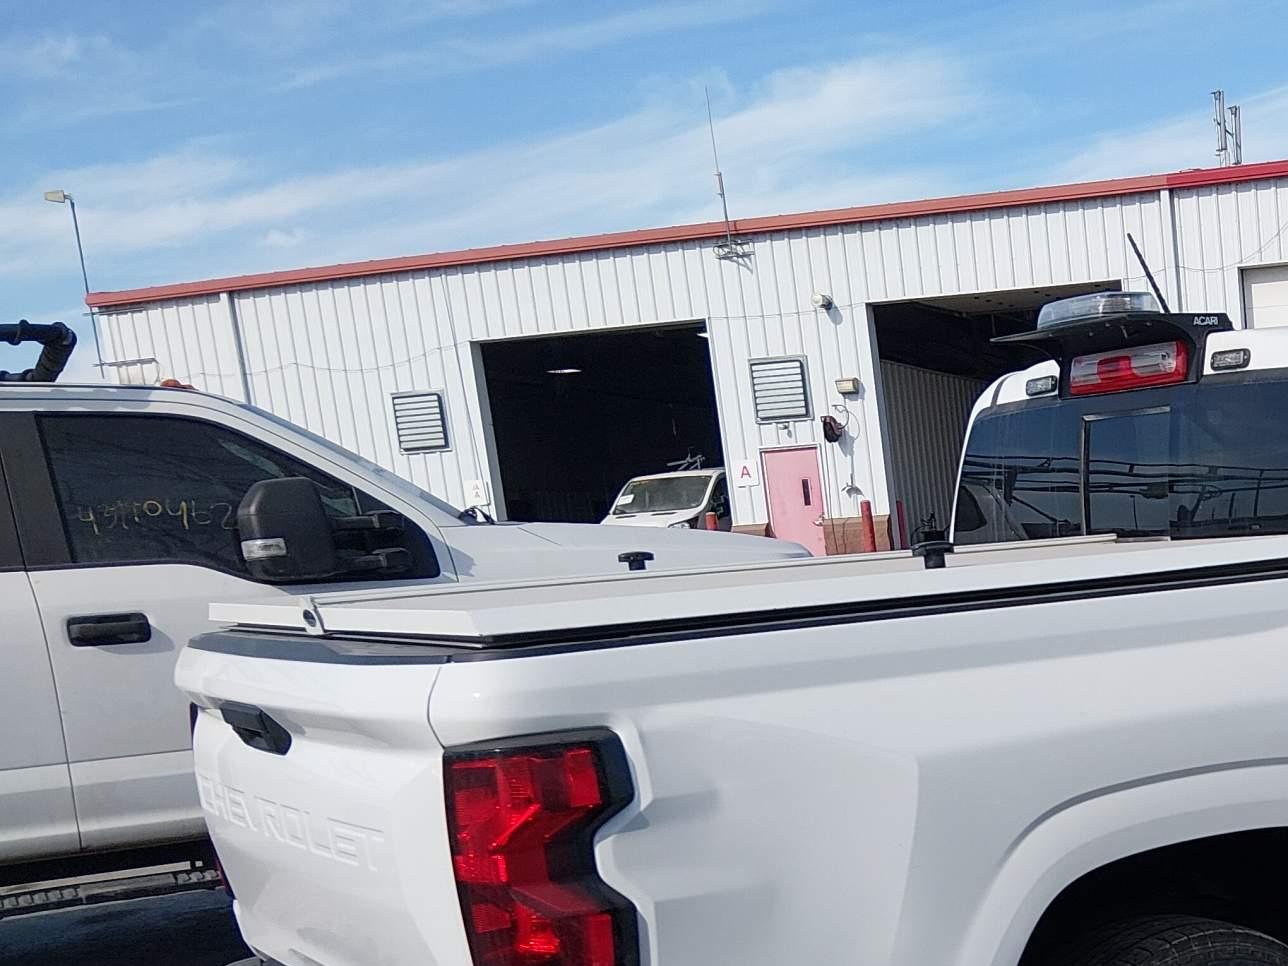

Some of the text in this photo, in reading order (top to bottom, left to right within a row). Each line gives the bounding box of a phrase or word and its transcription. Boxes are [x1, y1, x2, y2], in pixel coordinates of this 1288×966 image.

[1193, 316, 1219, 326] ACARI
[740, 465, 752, 479] A
[198, 775, 385, 872] CHEVROLET
